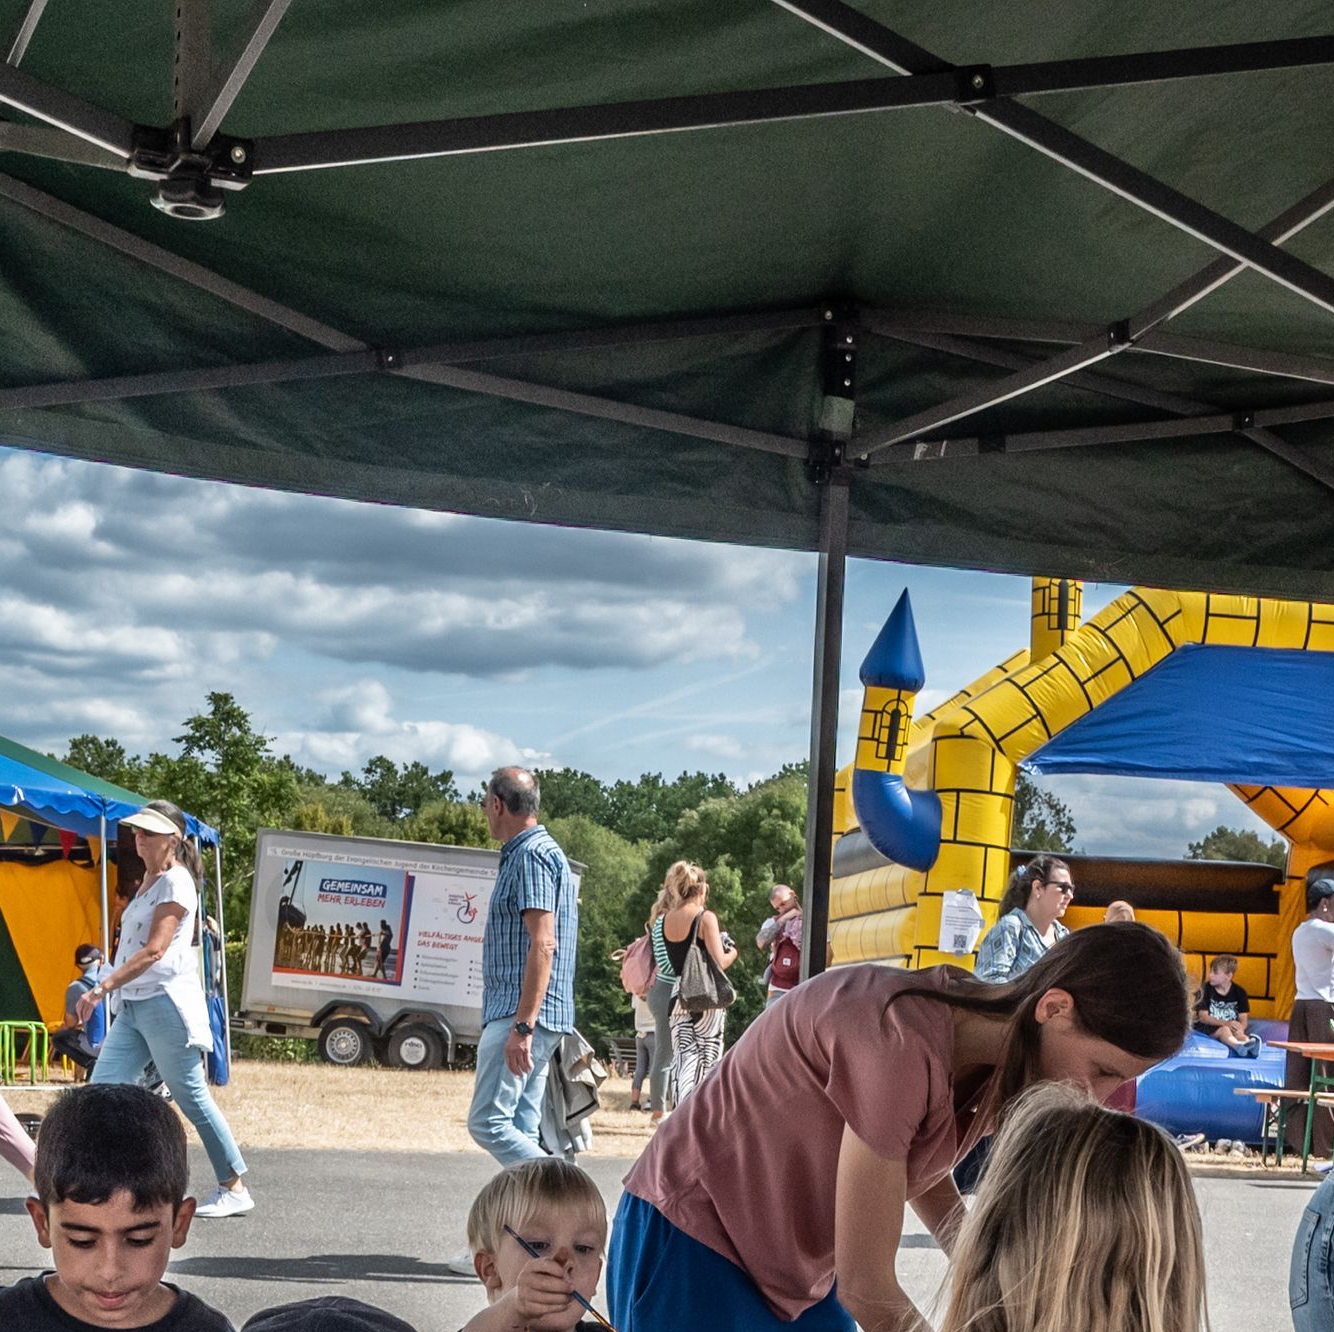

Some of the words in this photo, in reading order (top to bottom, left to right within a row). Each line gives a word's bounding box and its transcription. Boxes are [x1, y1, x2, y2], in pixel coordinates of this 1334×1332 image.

[322, 880, 384, 896] GEMEINSAM
[317, 893, 342, 905] MEHR
[344, 896, 386, 908] ERLEBEN
[417, 940, 430, 948] DAS
[432, 941, 458, 950] BEWEGT
